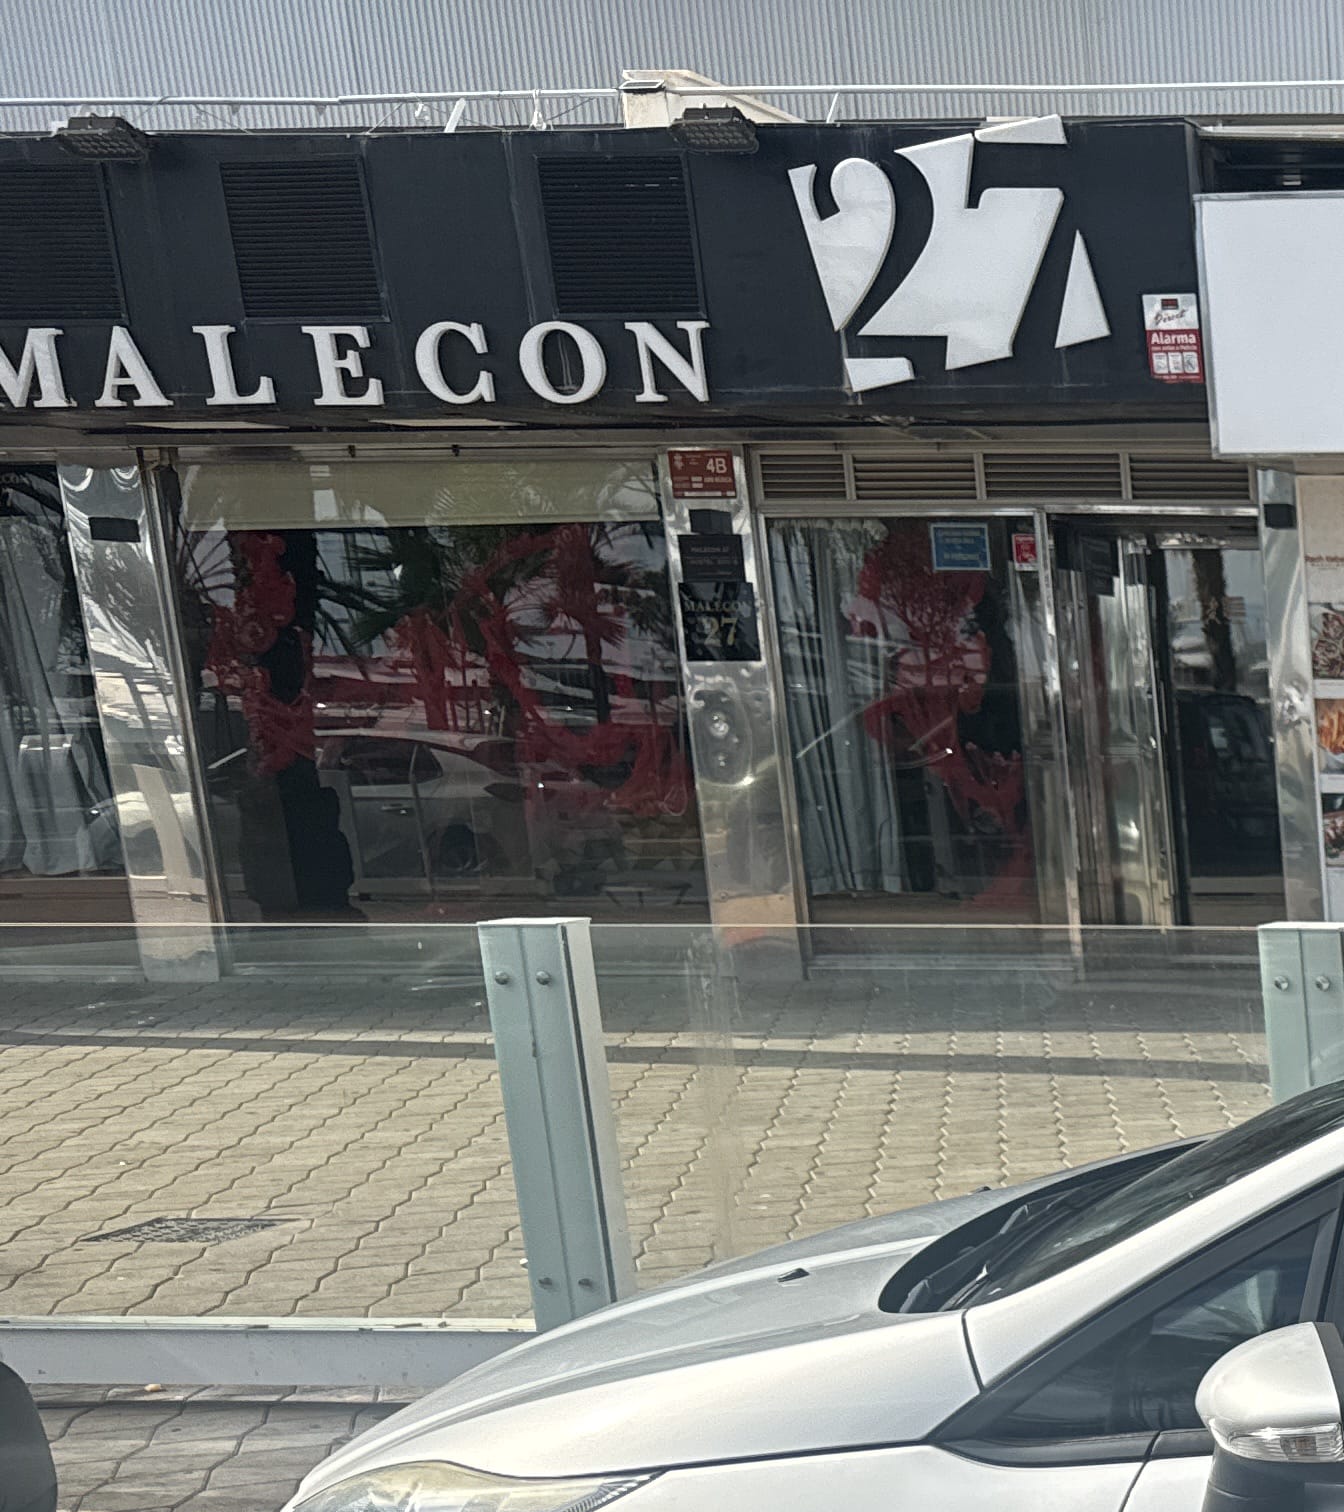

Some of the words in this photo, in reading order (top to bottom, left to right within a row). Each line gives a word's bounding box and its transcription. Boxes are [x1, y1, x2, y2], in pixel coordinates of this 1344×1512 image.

[1151, 332, 1197, 345] Alarma
[0, 320, 711, 408] MALECON
[706, 457, 728, 474] 4B
[702, 616, 738, 648] 27
